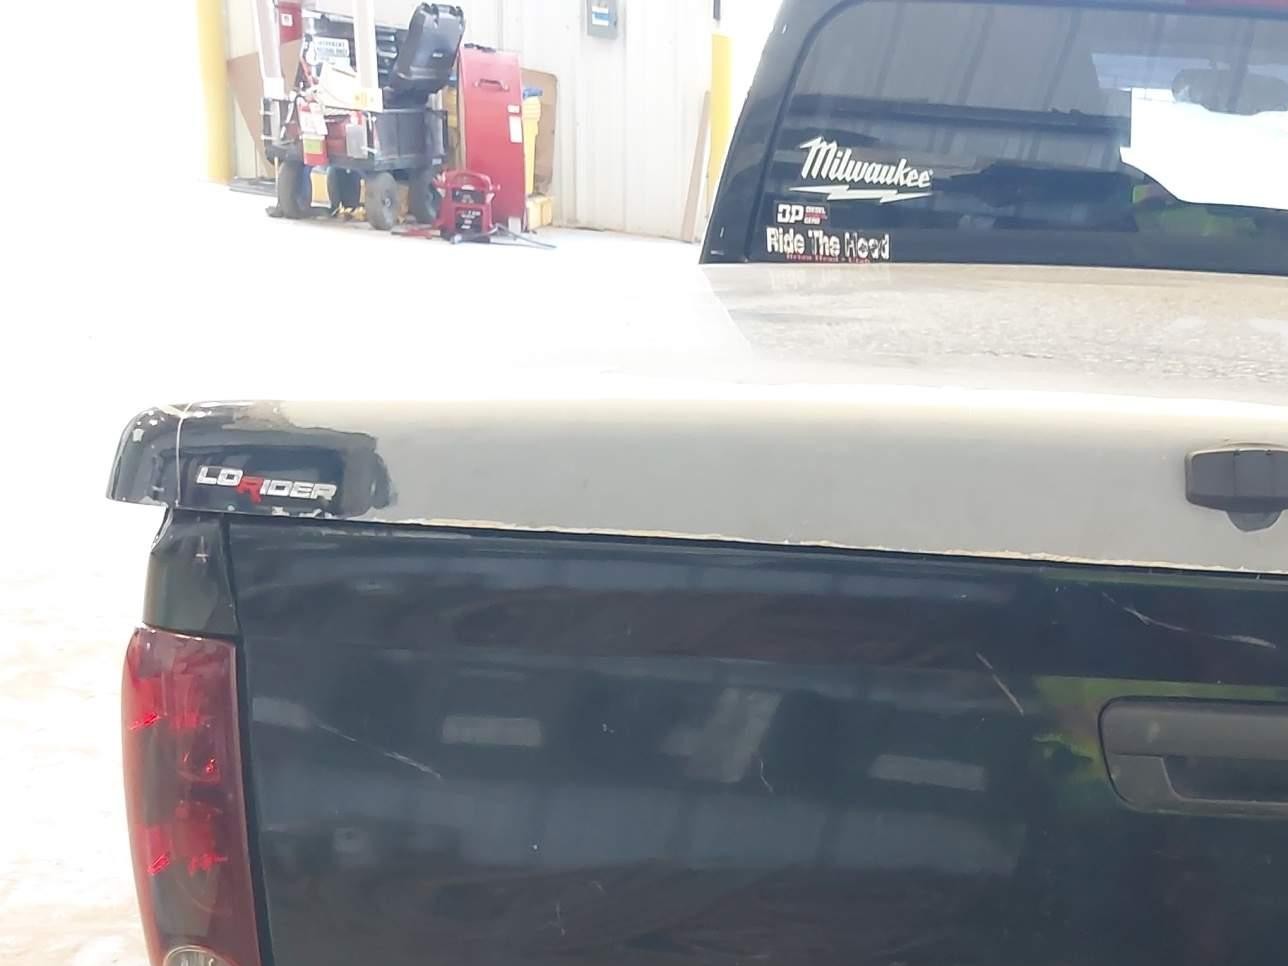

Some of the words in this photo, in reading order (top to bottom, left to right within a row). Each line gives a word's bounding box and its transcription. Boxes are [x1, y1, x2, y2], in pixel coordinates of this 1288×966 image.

[800, 136, 933, 189] Milwaukee
[766, 226, 805, 255] Ride
[807, 229, 841, 257] The
